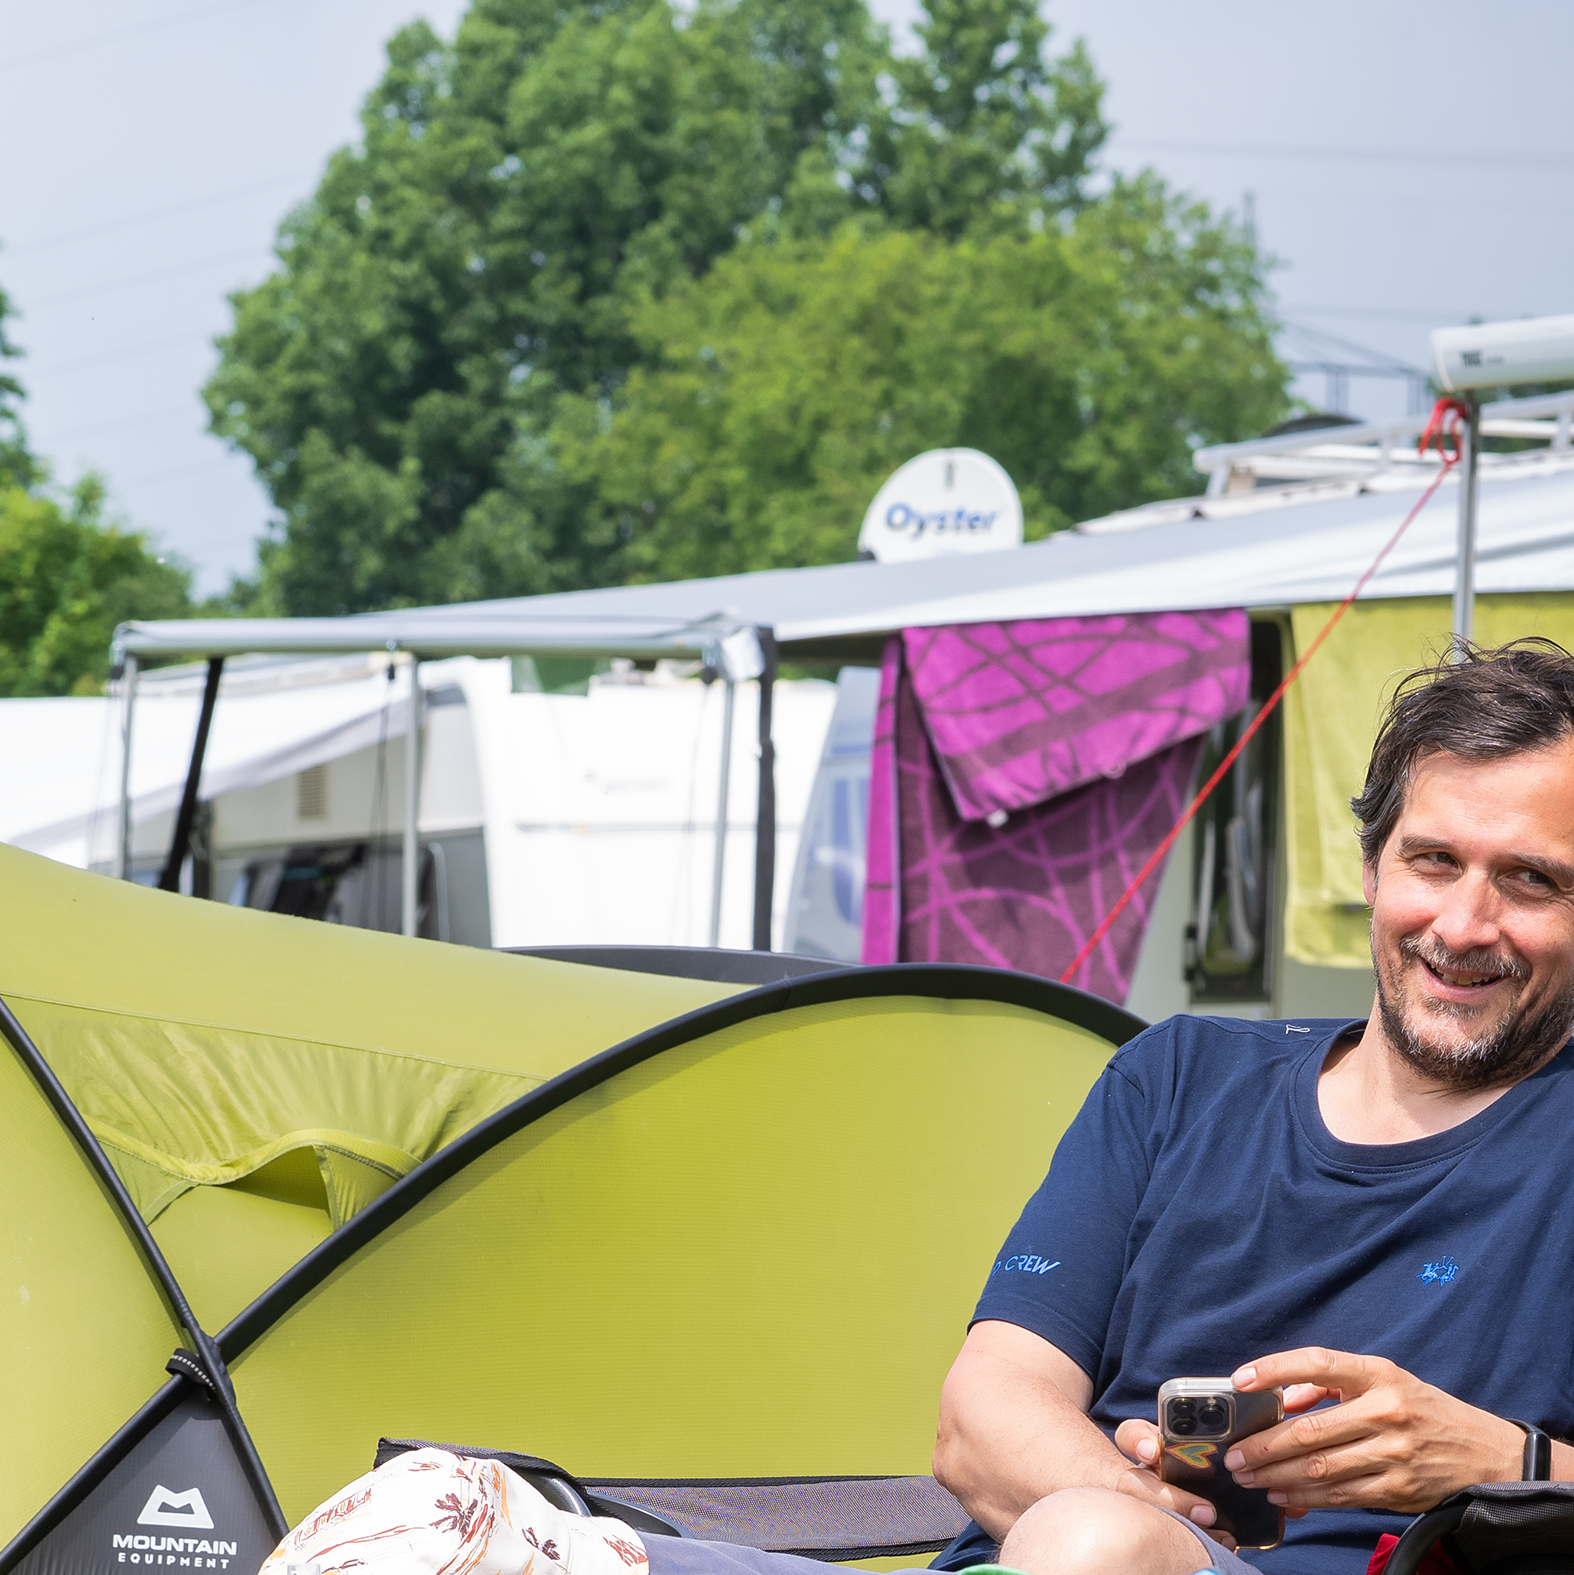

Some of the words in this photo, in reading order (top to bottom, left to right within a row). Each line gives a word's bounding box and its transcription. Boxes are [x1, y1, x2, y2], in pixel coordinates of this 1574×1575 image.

[886, 501, 997, 540] Oyster
[1004, 1254, 1061, 1275] CREW
[112, 1533, 237, 1556] MOUNTAIN
[117, 1552, 230, 1569] EQUIPMENT
